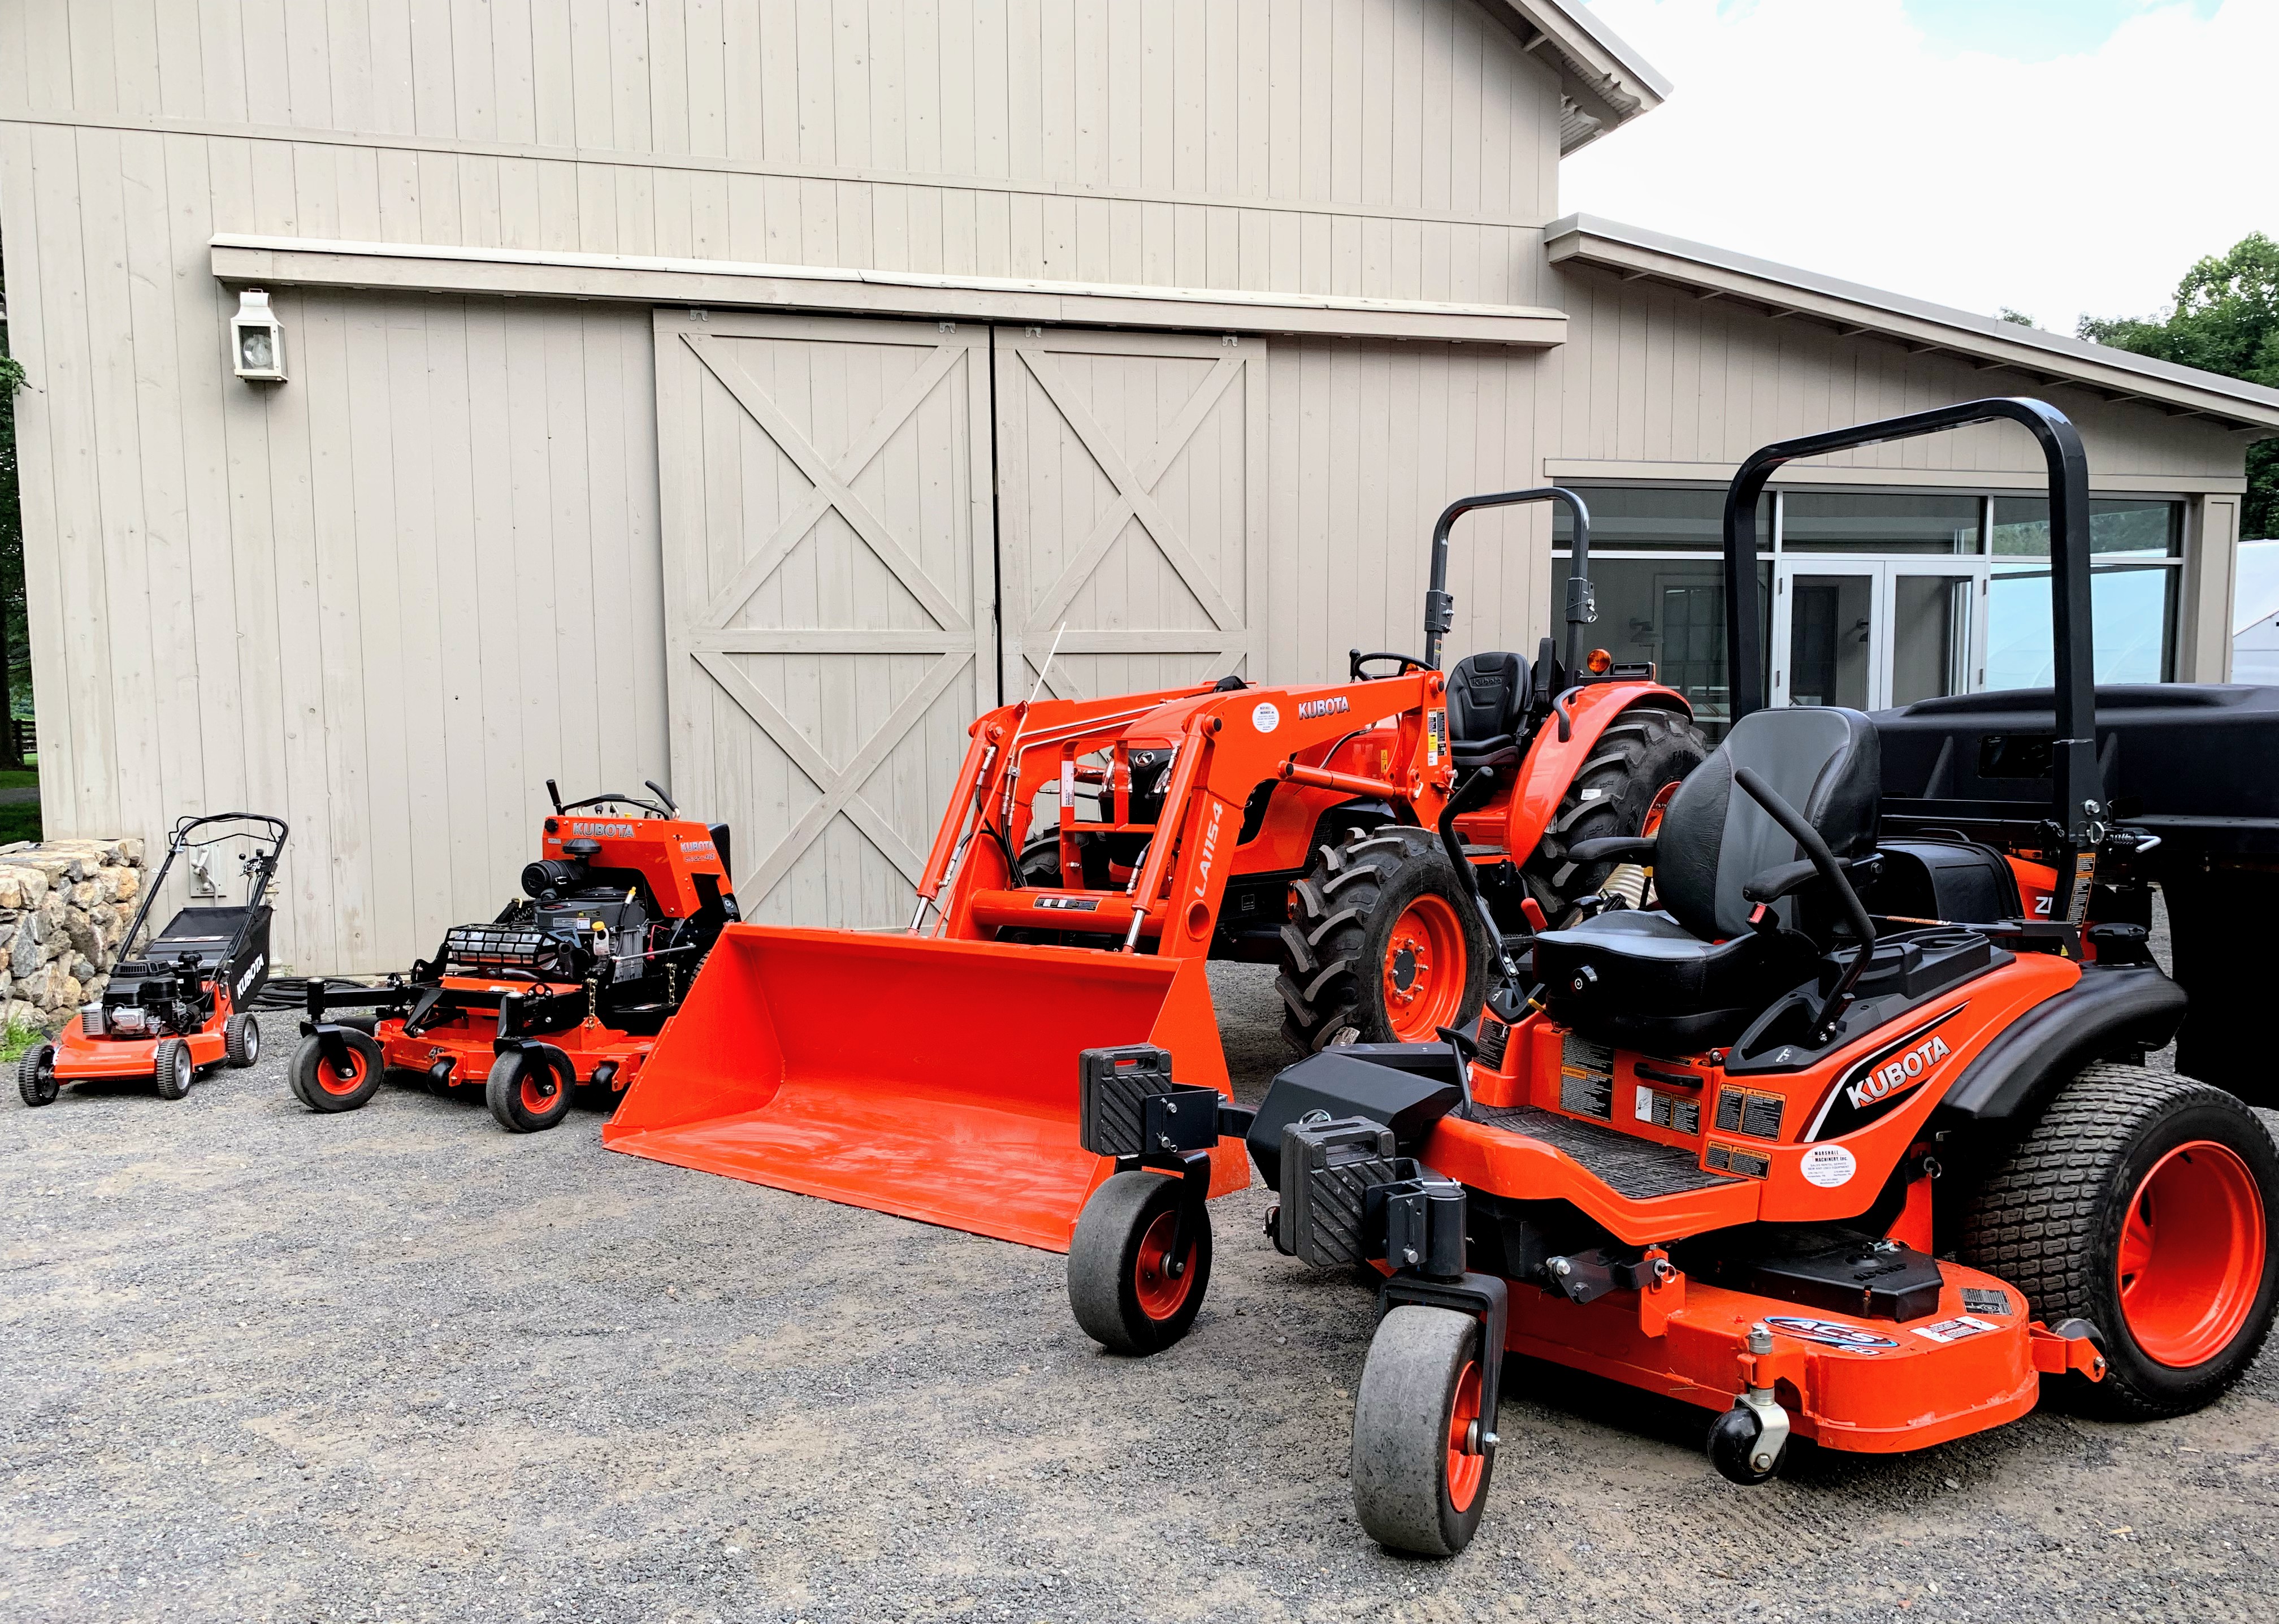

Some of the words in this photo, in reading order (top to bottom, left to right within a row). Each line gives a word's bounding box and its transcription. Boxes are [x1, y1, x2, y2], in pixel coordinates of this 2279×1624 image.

[1298, 695, 1350, 721] KUBOTA
[573, 821, 635, 838] KUBOTA
[680, 841, 715, 853] KUBOTA
[1194, 801, 1223, 898] LA1154
[237, 953, 265, 1000] KUBOTA
[1846, 1035, 1952, 1110] KUBOTA
[1740, 1148, 1767, 1158] ADVERTENCIA
[1779, 1320, 1884, 1343] ACS
[1838, 1345, 1881, 1356] 60
